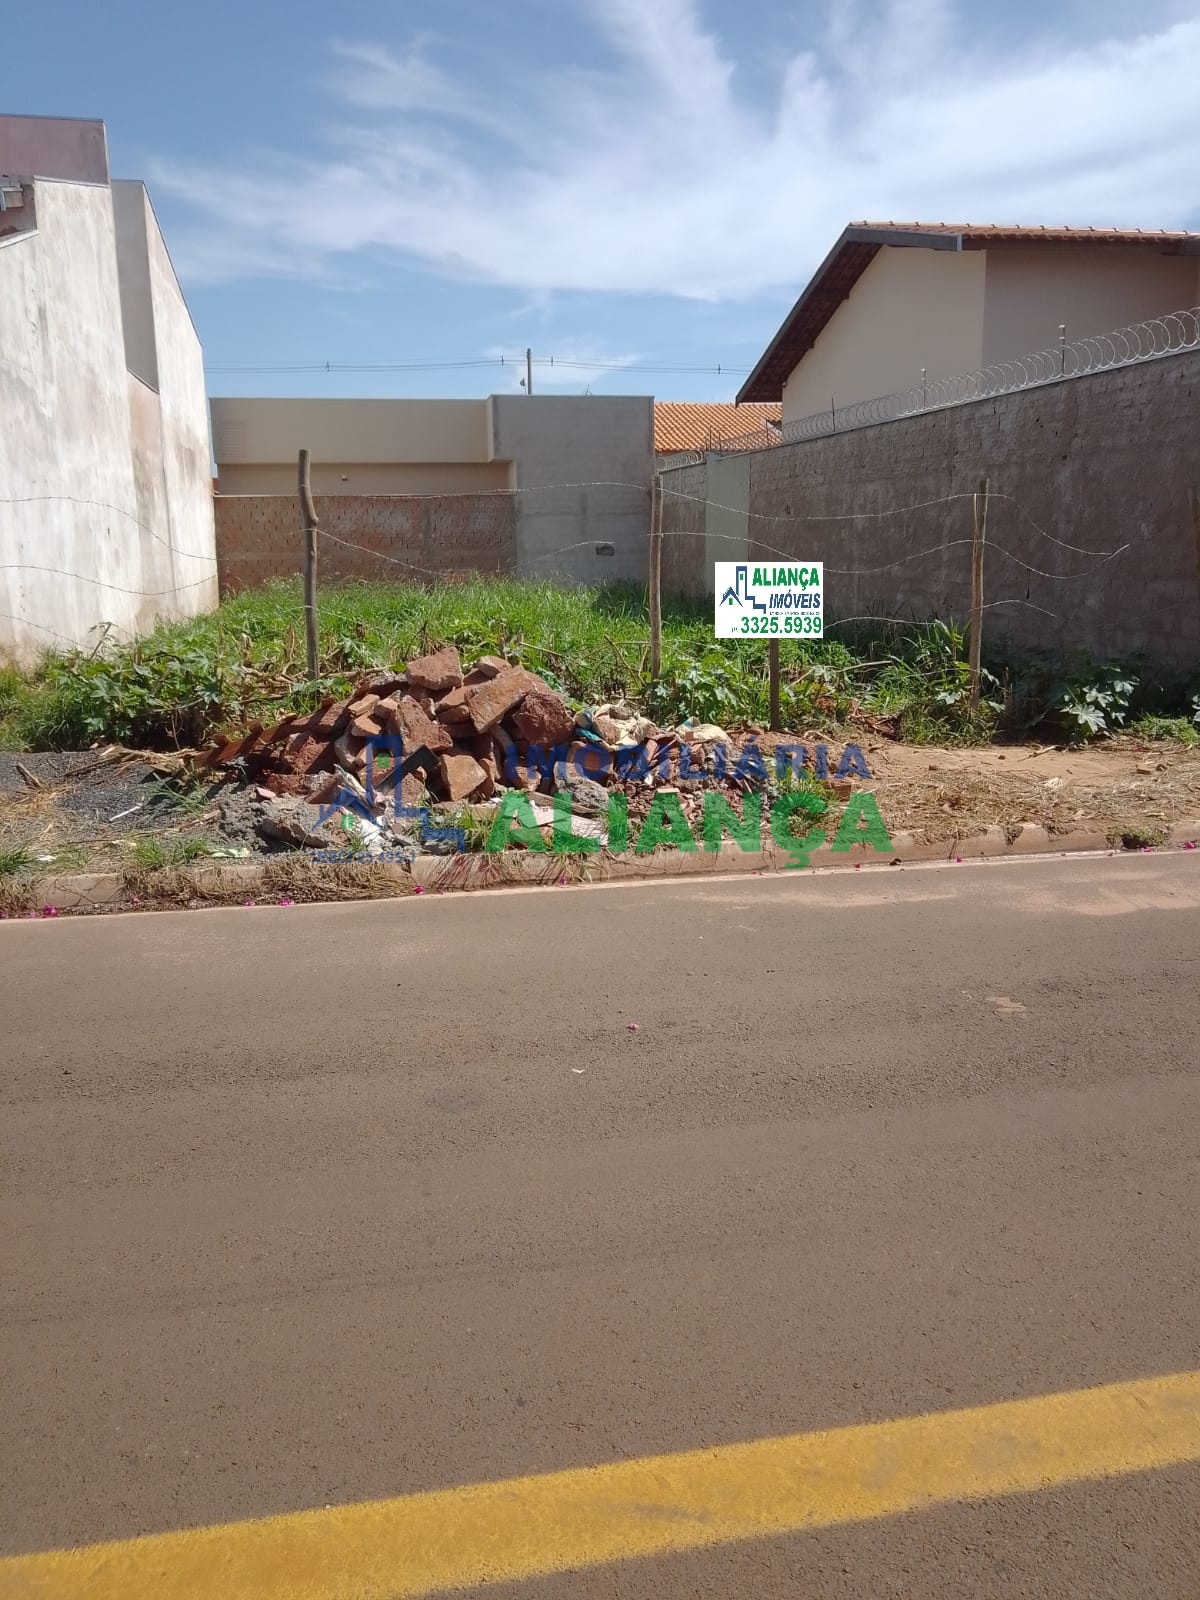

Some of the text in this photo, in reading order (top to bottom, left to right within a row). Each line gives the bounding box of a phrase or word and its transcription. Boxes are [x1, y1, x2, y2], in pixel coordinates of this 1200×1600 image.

[752, 568, 820, 590] ALIANÇA
[769, 589, 821, 608] IMÓVEIS
[741, 616, 822, 634] 3325.5939
